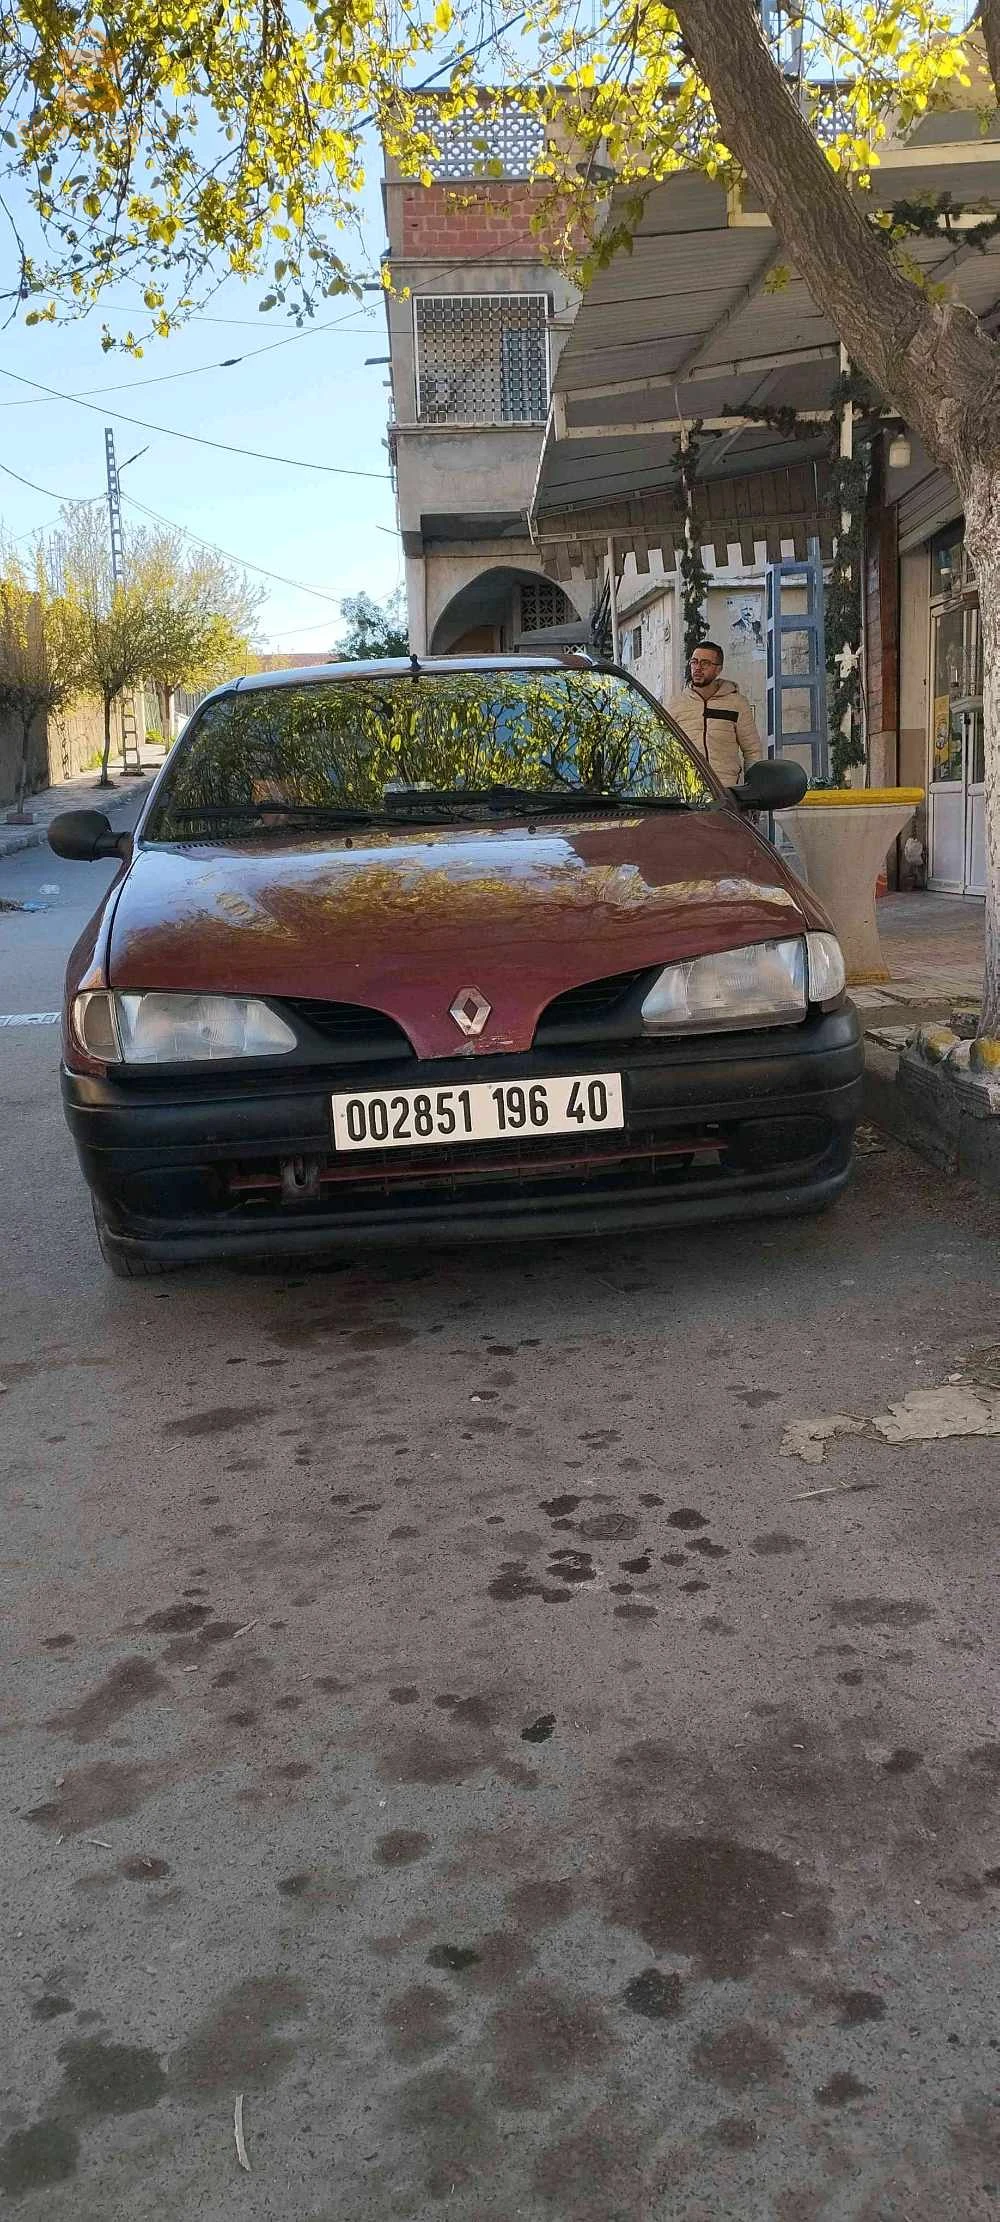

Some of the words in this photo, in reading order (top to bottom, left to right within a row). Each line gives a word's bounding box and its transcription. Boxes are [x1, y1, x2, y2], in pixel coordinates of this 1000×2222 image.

[346, 1090, 473, 1141] 002851
[492, 1085, 548, 1129] 196
[566, 1080, 607, 1123] 40
